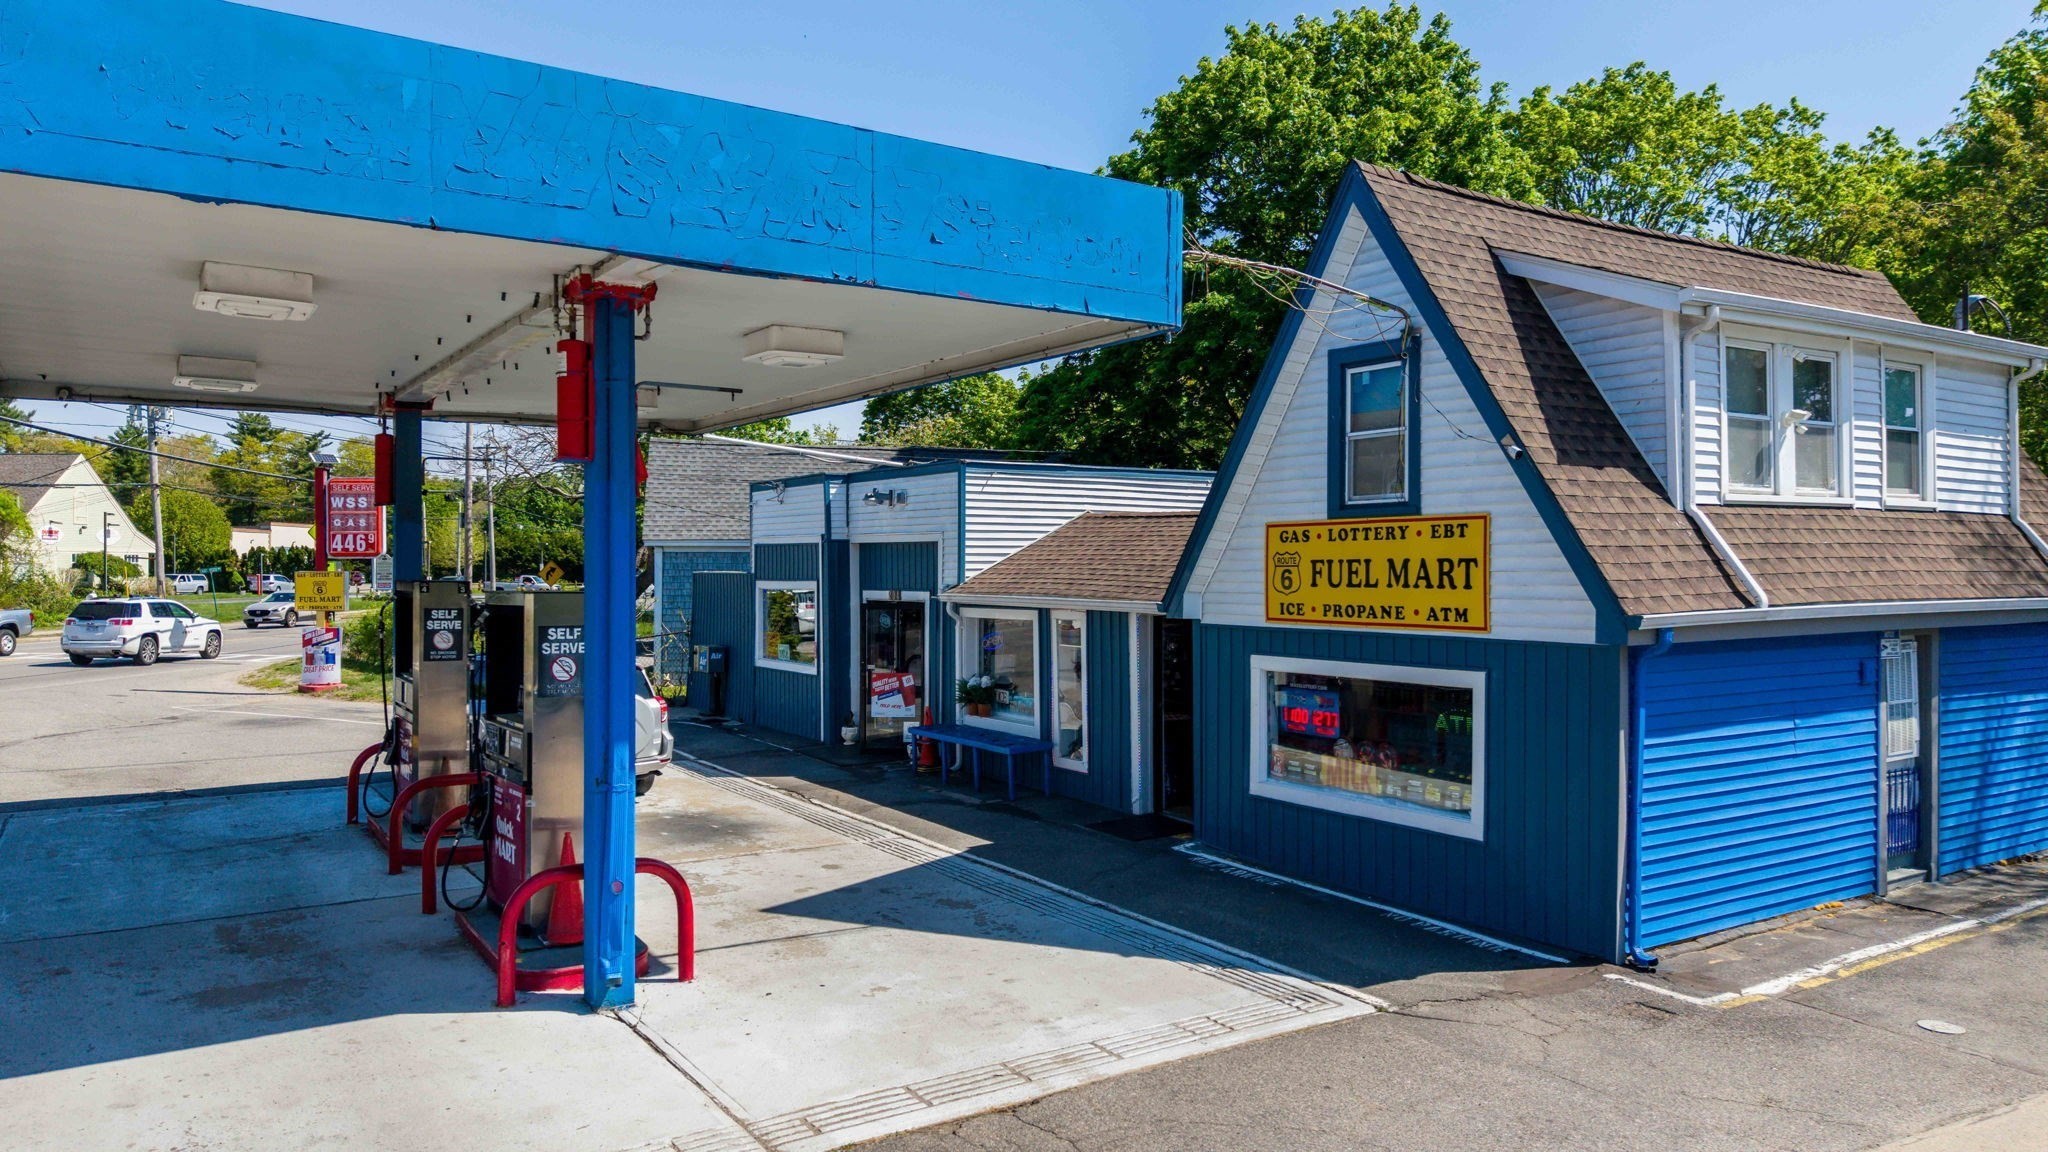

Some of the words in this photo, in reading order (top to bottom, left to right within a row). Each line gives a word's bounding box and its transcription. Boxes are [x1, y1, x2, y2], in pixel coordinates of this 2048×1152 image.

[331, 496, 368, 509] WSS
[1279, 529, 1310, 543] GAS
[1327, 525, 1410, 542] LOTTERY
[1430, 523, 1469, 539] EBT
[332, 534, 366, 552] 446
[1276, 556, 1298, 566] ROUTE
[1280, 568, 1293, 590] 6
[1310, 558, 1379, 589] FUEL
[1386, 557, 1479, 590] MART
[316, 586, 324, 594] 6
[431, 609, 458, 619] SELF
[1279, 602, 1306, 616] ICE
[1322, 604, 1406, 620] PROPANE
[1426, 606, 1469, 623] ATM
[426, 620, 462, 630] SERVE
[547, 627, 582, 641] SELF
[541, 642, 585, 655] SERVE
[710, 652, 723, 660] Air
[516, 804, 521, 822] 2
[496, 814, 514, 840] Quick
